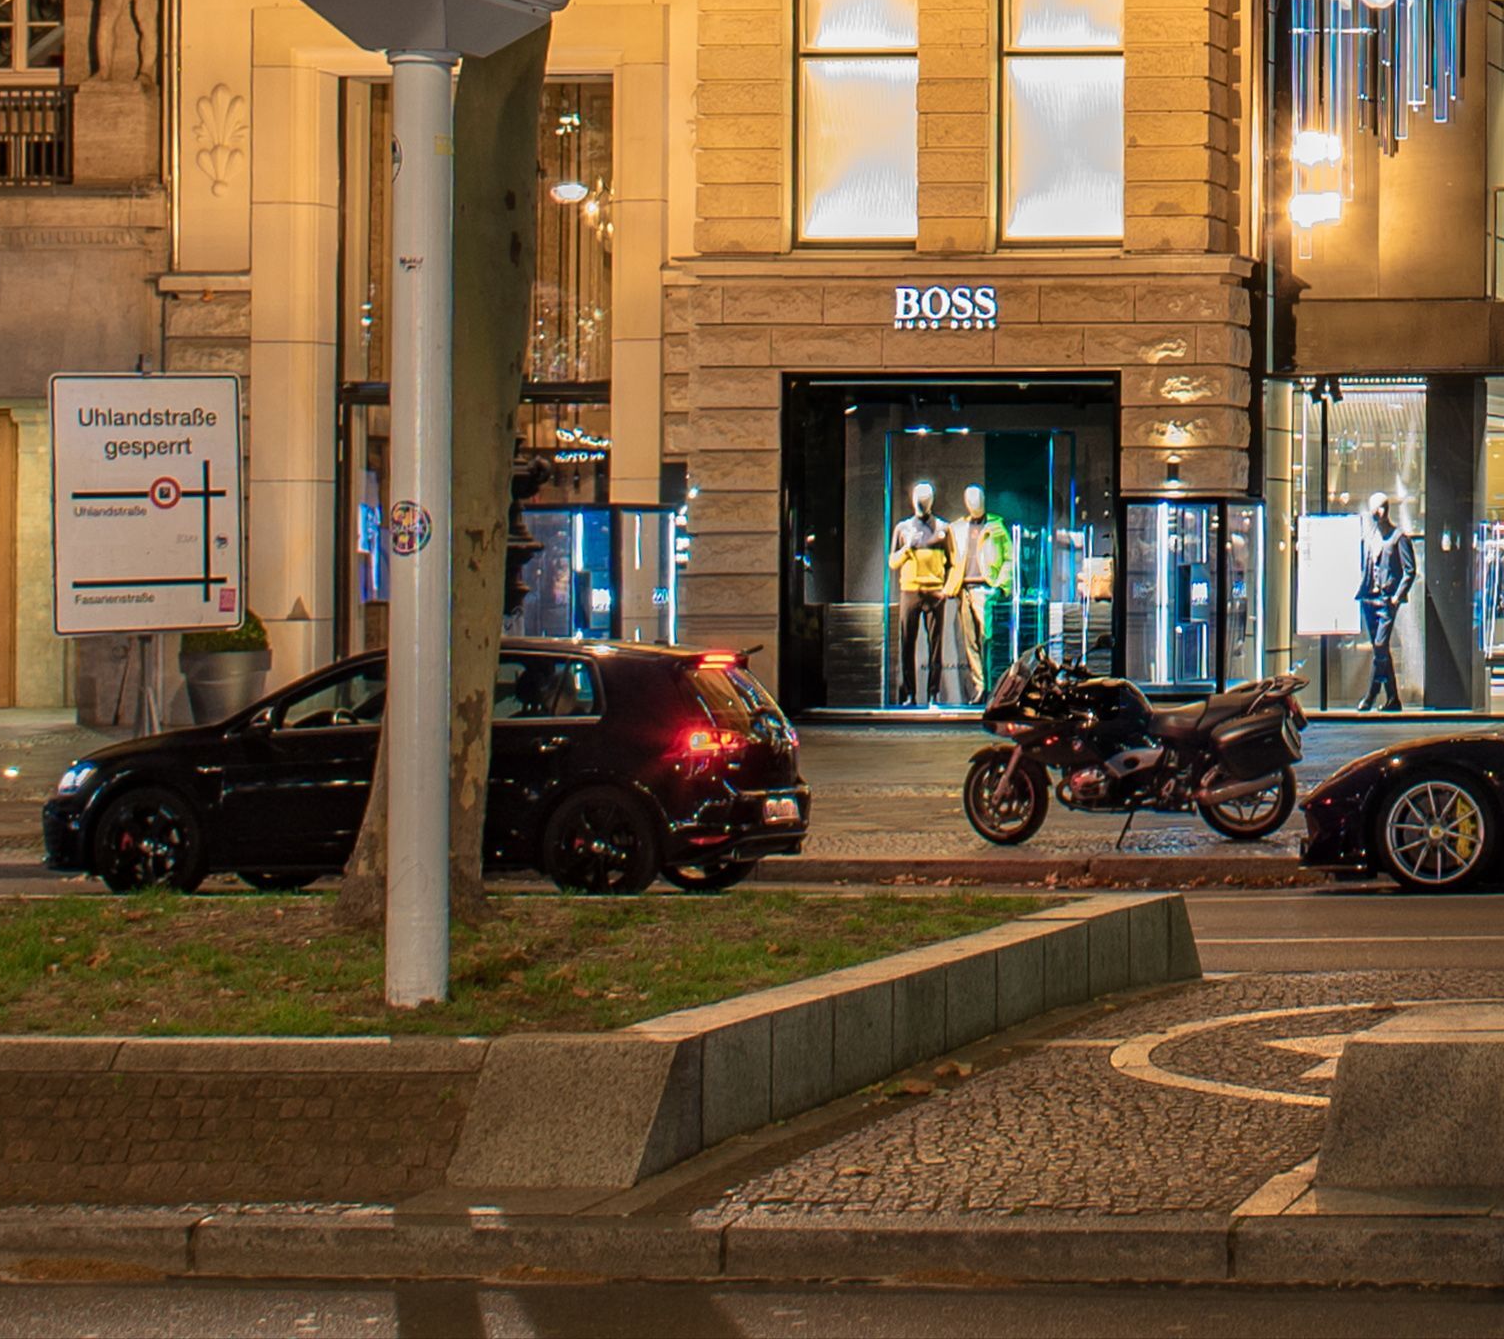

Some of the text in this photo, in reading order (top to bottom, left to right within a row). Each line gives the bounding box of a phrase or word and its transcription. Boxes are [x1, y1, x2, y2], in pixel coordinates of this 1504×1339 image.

[895, 286, 998, 319] BOSS
[894, 319, 997, 330] HUGO BOSS
[77, 406, 217, 428] Uhlandstraße
[104, 437, 193, 461] gesperrt
[73, 505, 148, 518] Uhlandstraße
[74, 592, 156, 606] Fasanenstraße
